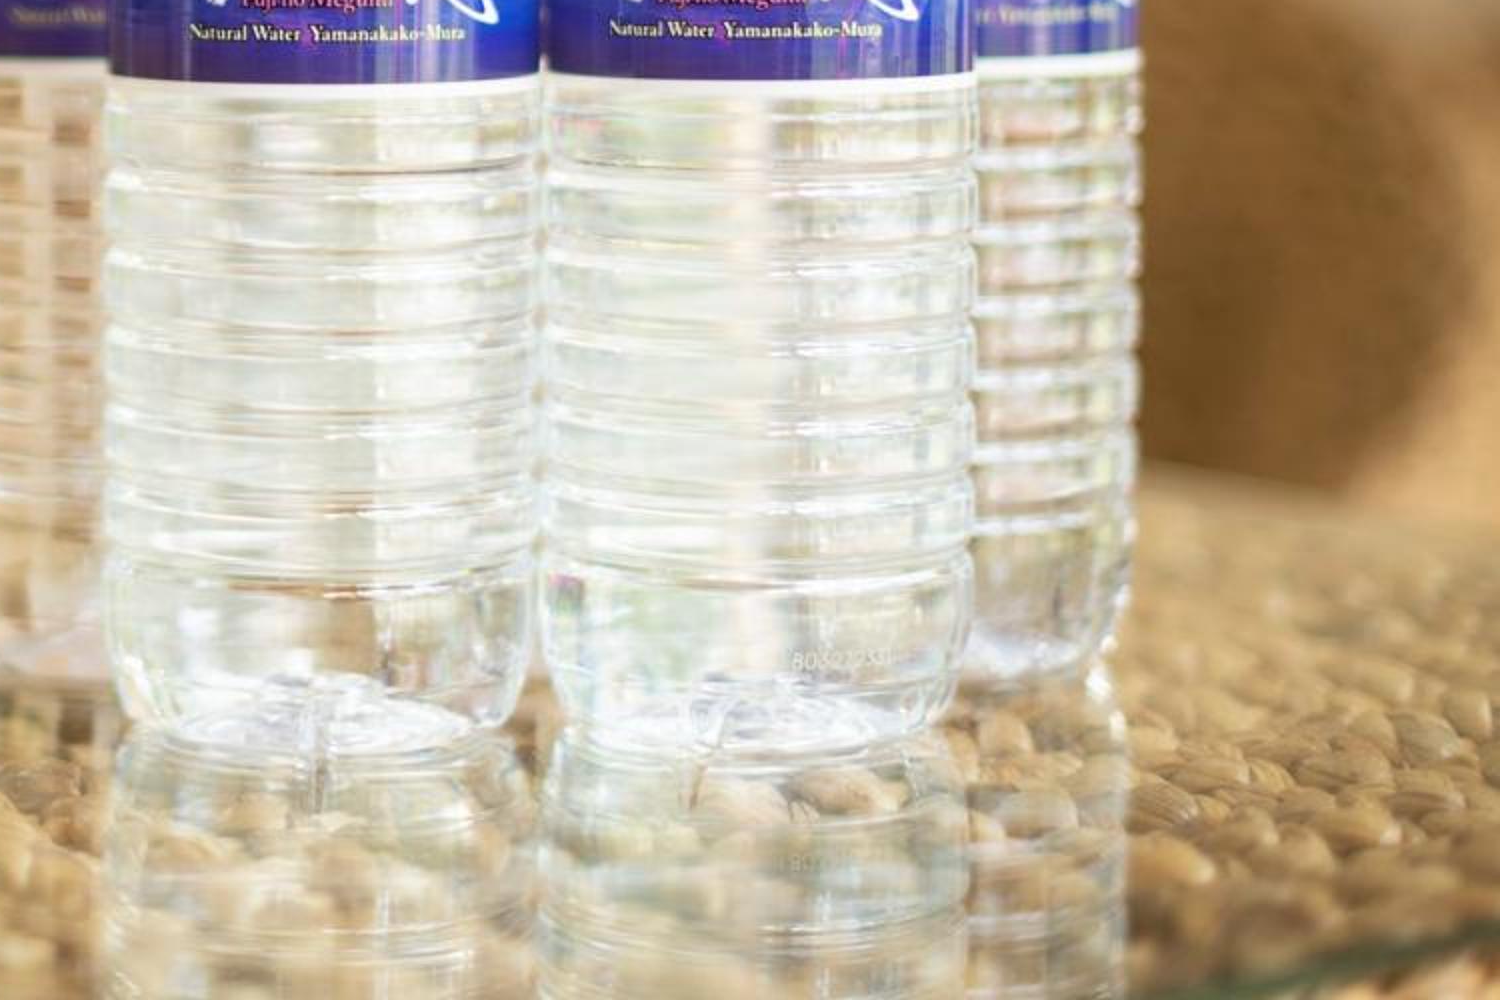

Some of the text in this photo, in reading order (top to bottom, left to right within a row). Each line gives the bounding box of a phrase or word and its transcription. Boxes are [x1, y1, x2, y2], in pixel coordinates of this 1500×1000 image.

[188, 23, 467, 42] Natural Water Yamanakako-Mura
[609, 19, 883, 39] Natural Water Yamanakako-Mura
